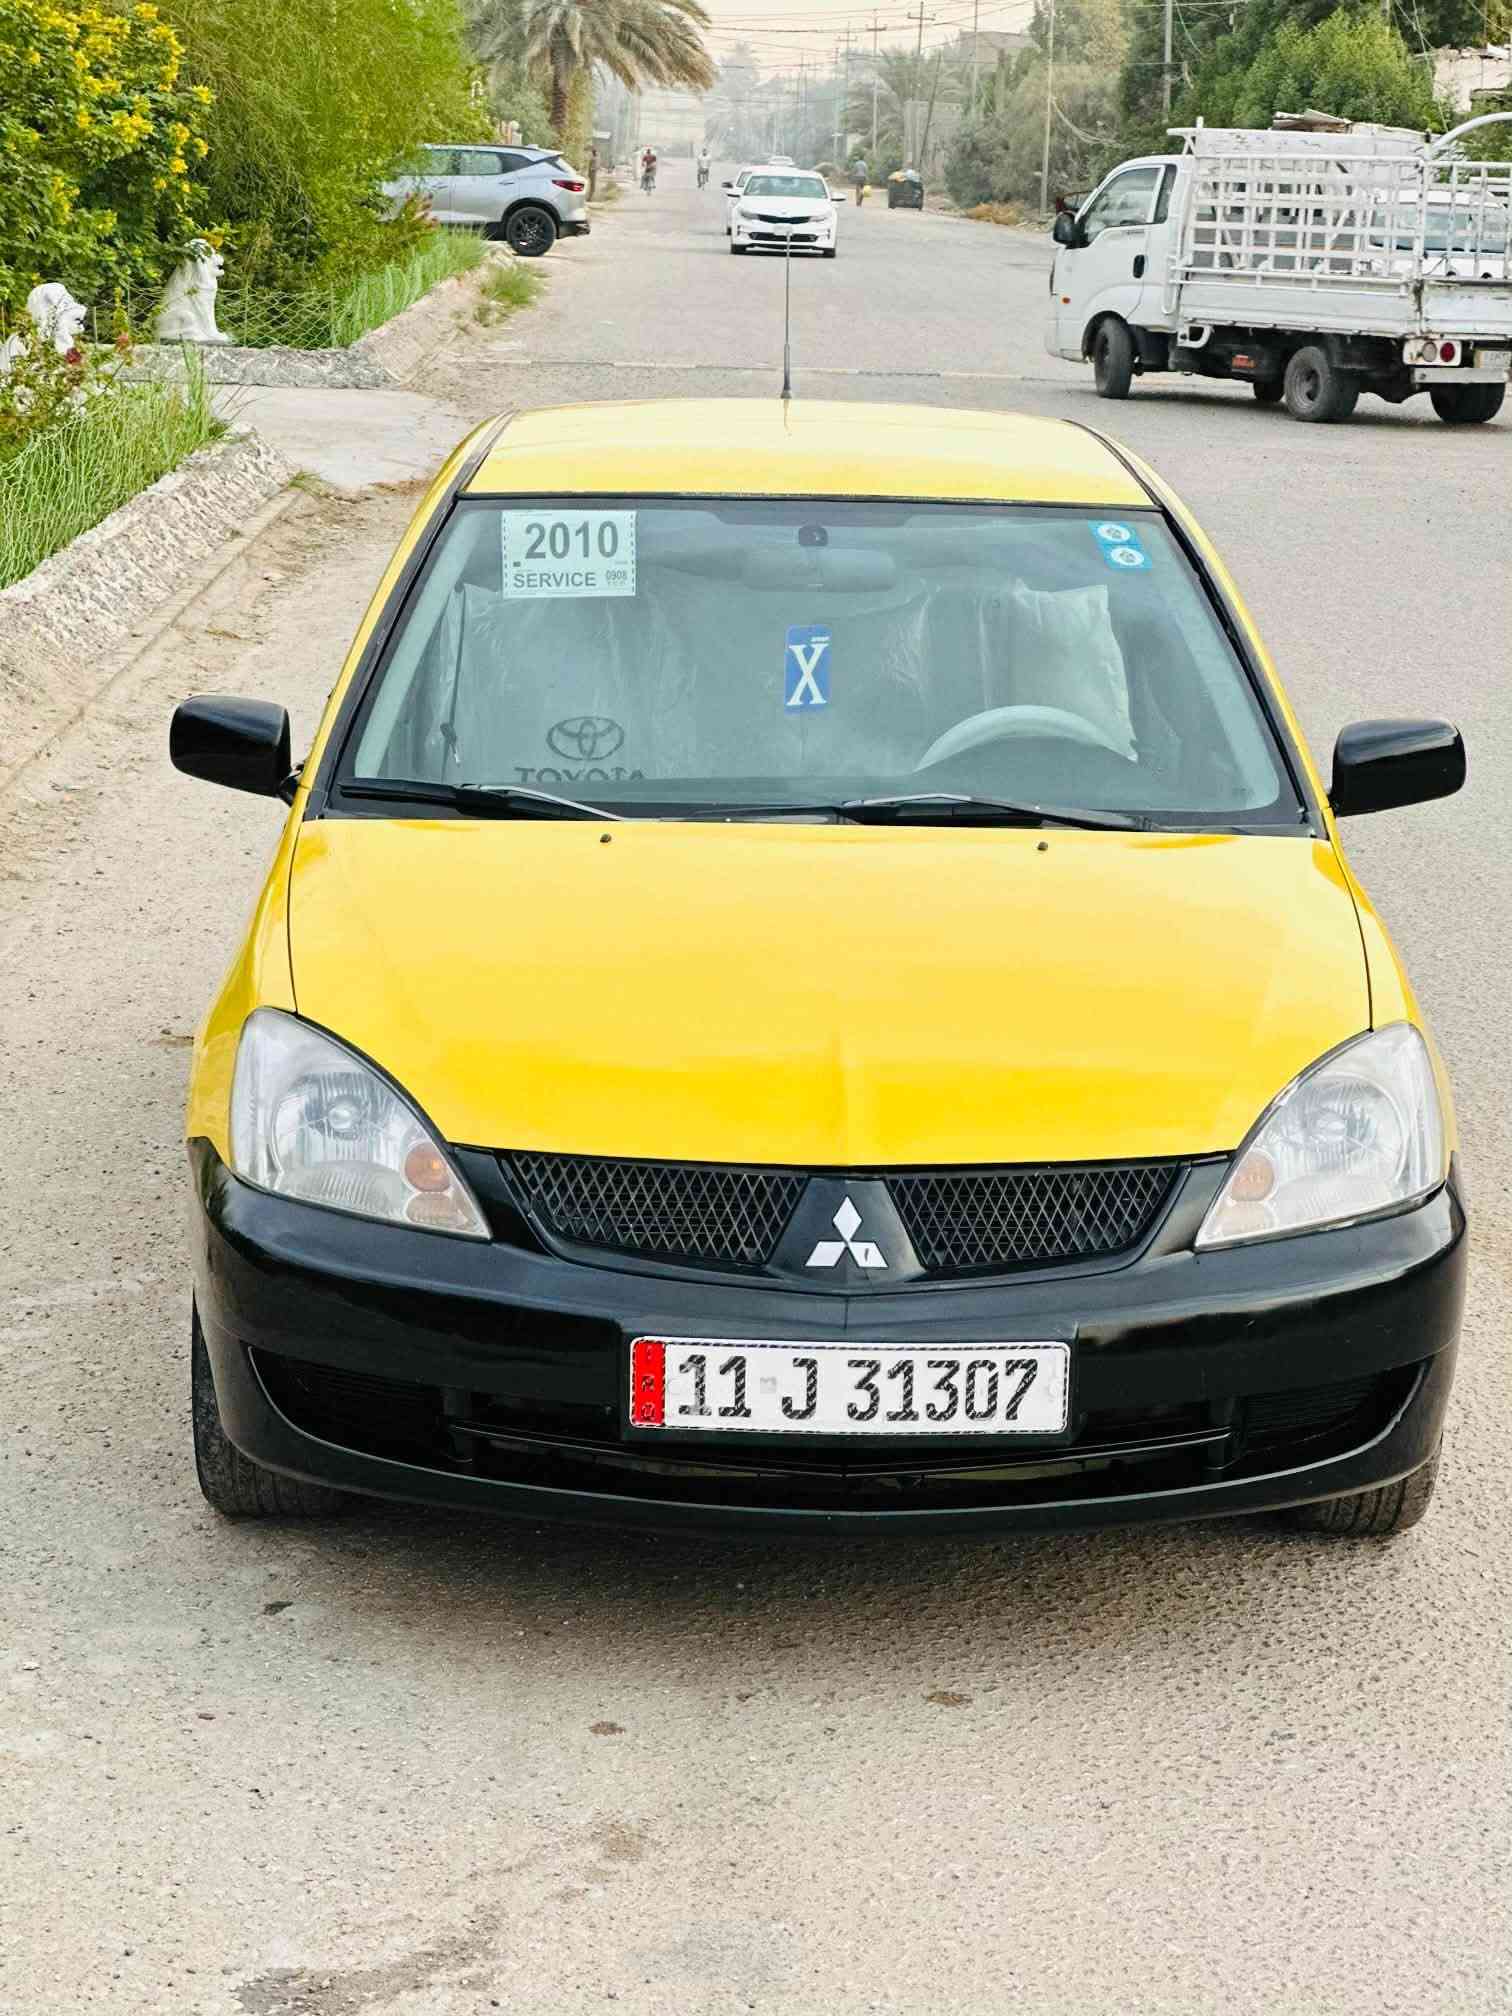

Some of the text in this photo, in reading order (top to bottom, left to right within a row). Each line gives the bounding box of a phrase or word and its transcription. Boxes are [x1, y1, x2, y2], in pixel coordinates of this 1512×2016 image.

[524, 520, 618, 559] 2010
[513, 572, 597, 588] SERVICE
[678, 1354, 752, 1417] 11
[781, 1357, 818, 1420] J
[847, 1359, 1038, 1421] 31307
